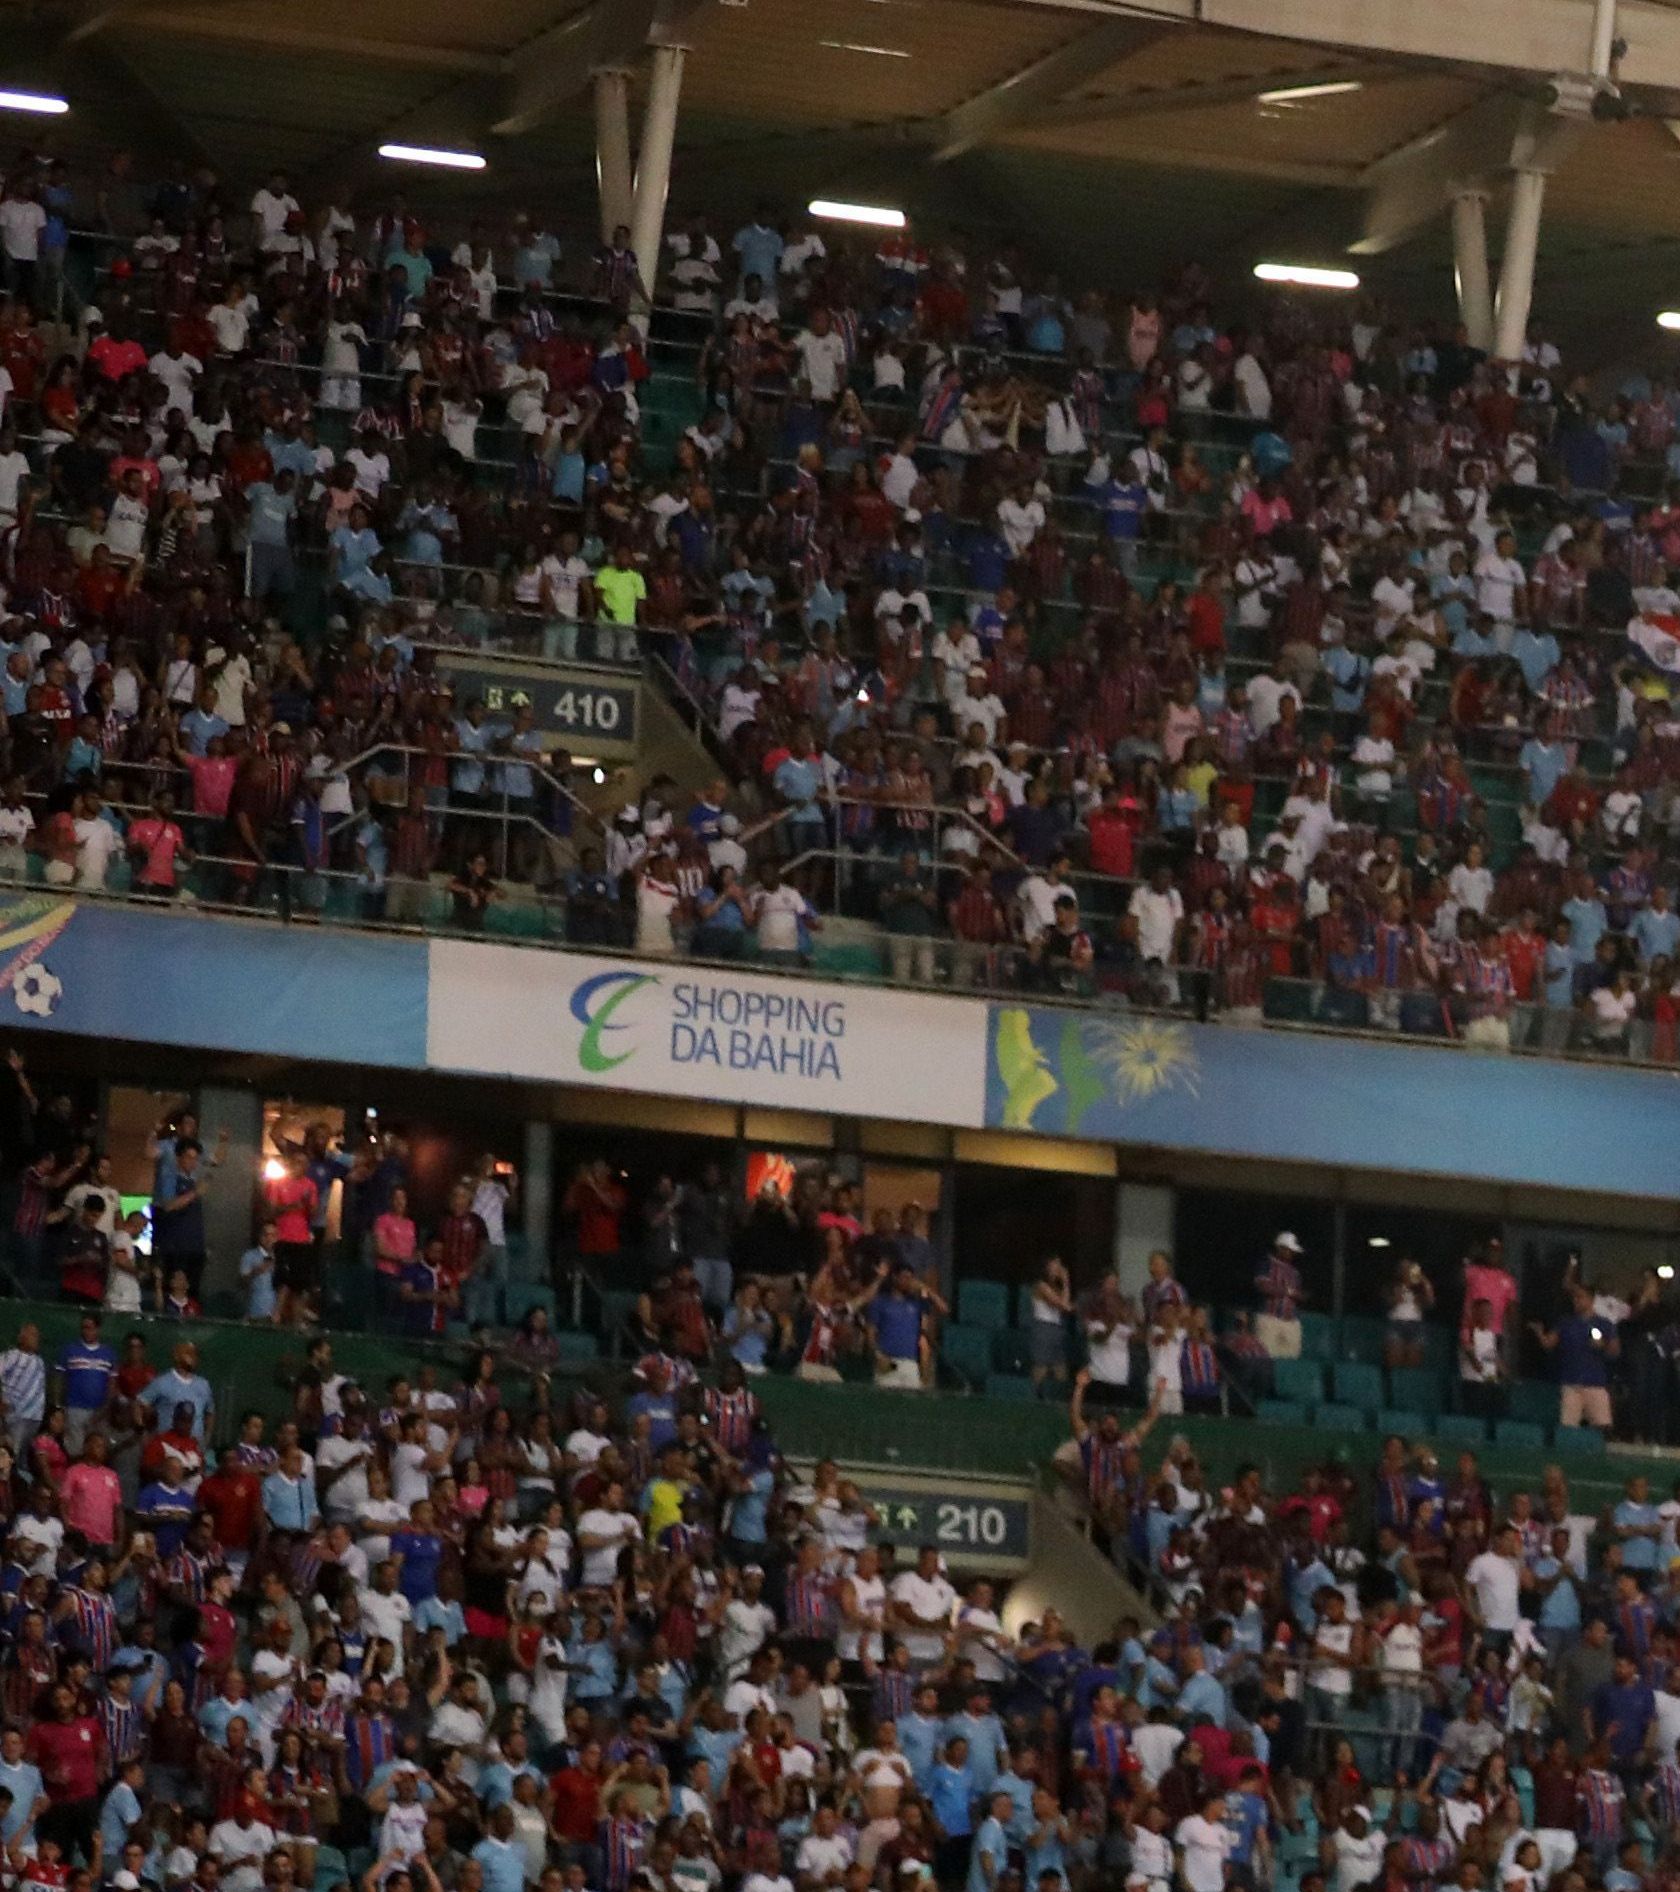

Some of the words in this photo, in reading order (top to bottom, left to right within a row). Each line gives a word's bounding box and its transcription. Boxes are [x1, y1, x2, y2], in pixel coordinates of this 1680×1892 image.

[553, 692, 620, 729] 410
[672, 983, 848, 1038] SHOPPING
[669, 1026, 724, 1065] DA
[727, 1030, 842, 1082] BAHIA
[936, 1503, 1006, 1547] 210
